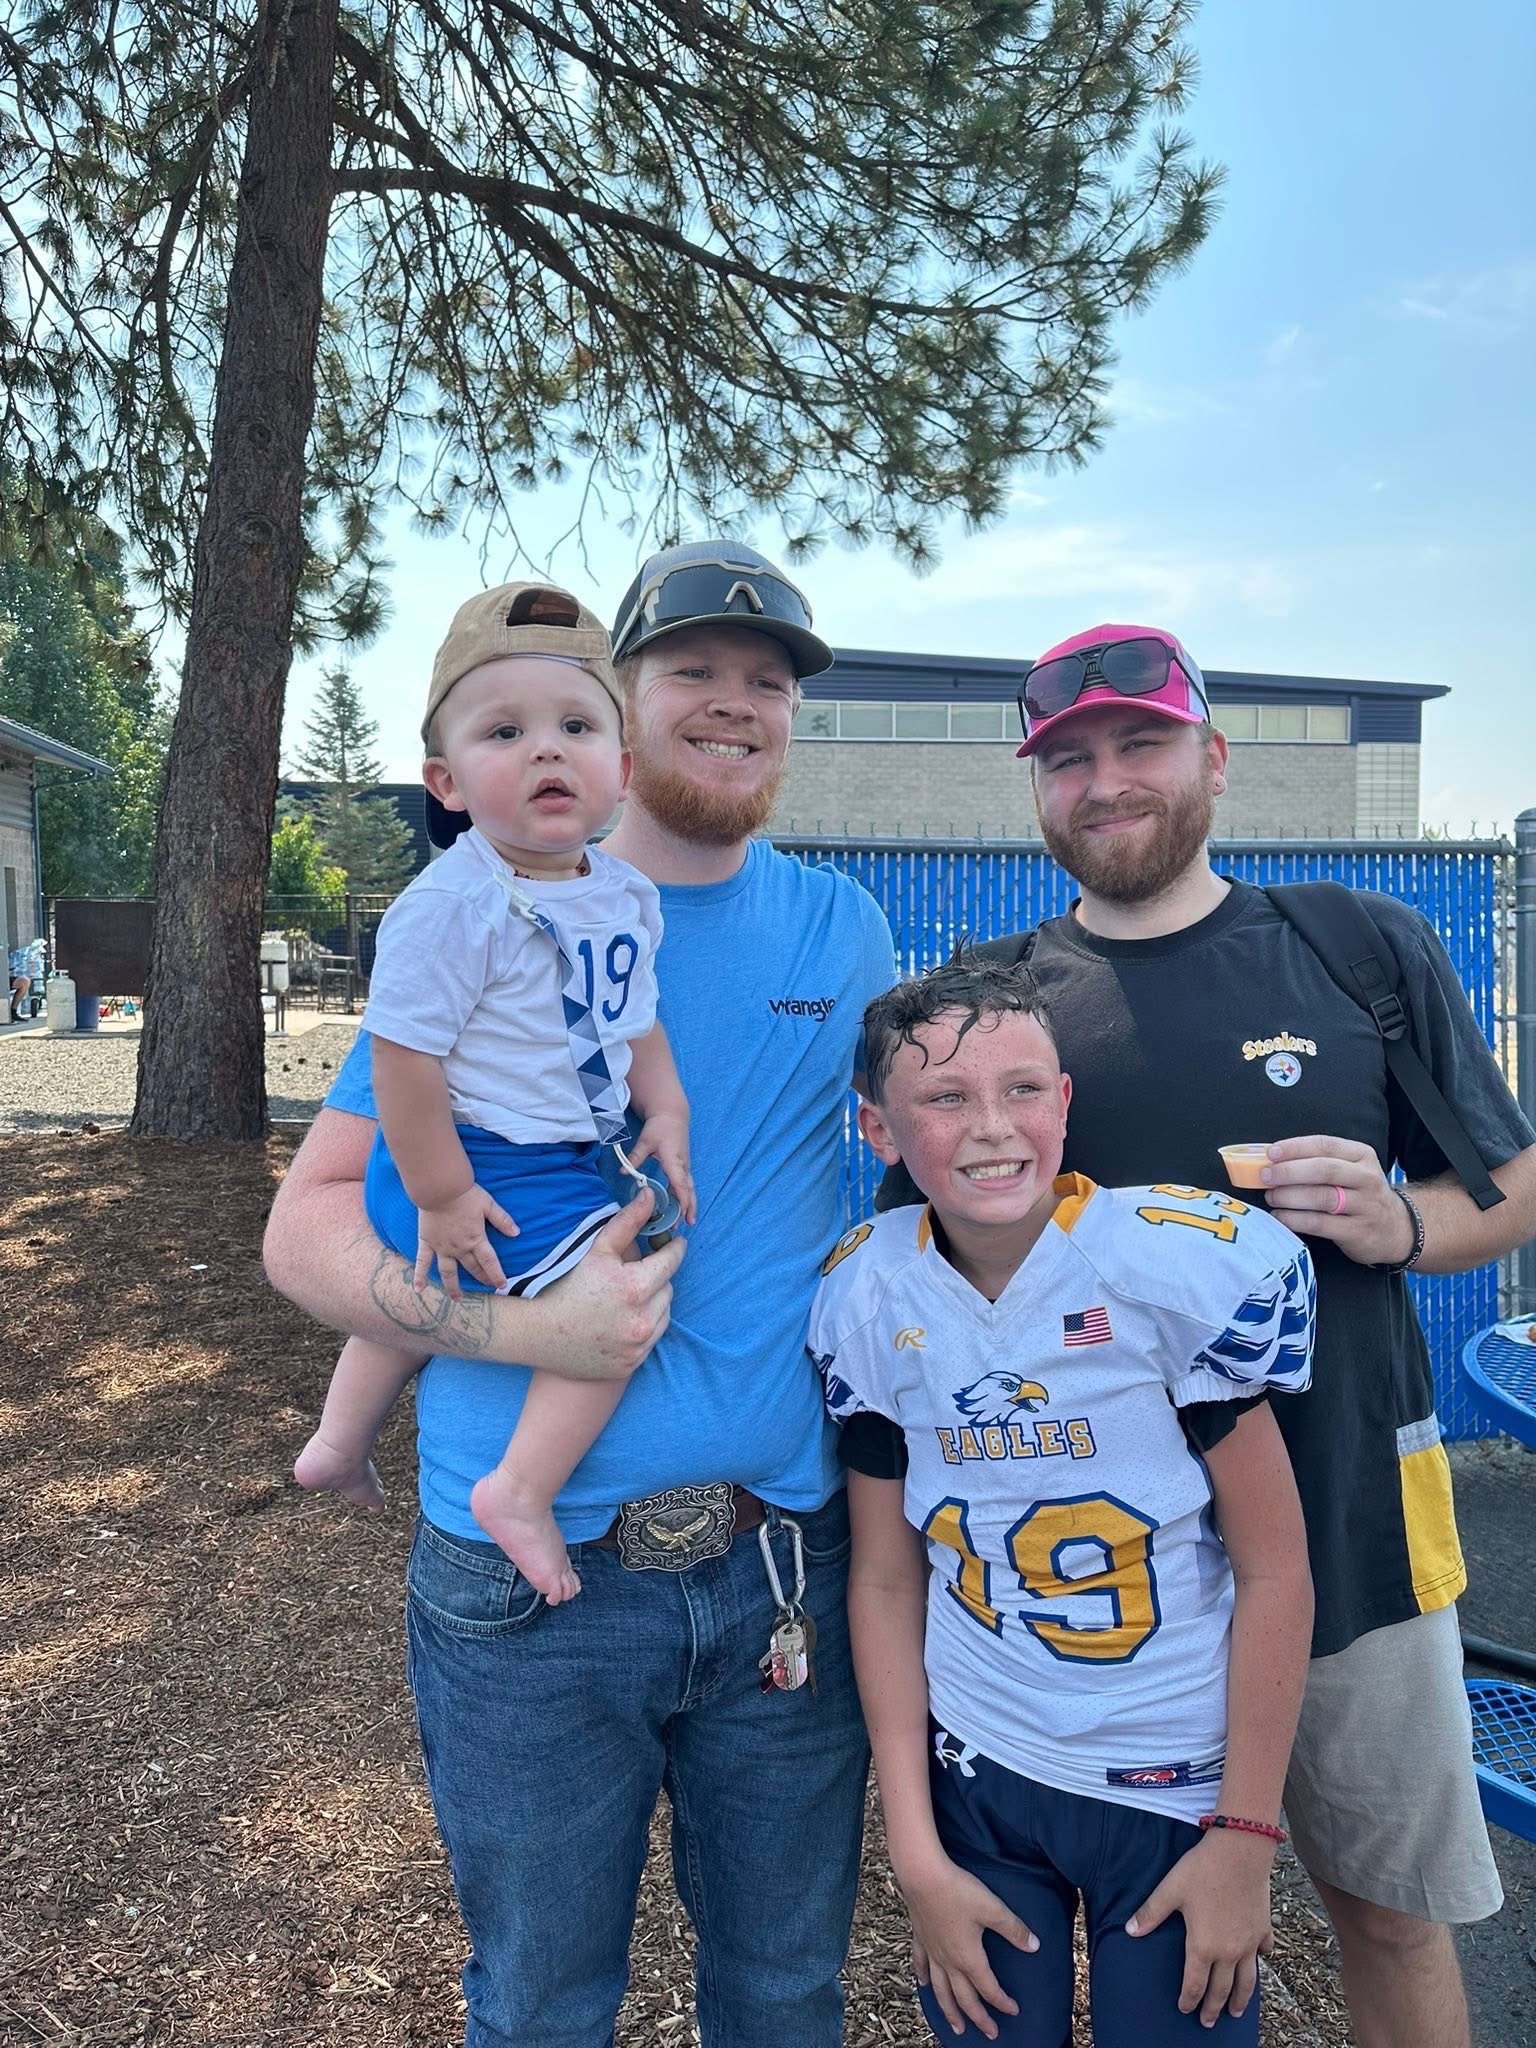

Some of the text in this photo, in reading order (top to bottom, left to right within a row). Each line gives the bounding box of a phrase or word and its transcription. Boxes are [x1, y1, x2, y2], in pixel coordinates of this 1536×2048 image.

[578, 933, 639, 1023] 19
[1242, 1031, 1317, 1061] Steelers
[935, 1417, 1097, 1465] EAGLES
[920, 1490, 1162, 1666] 19
